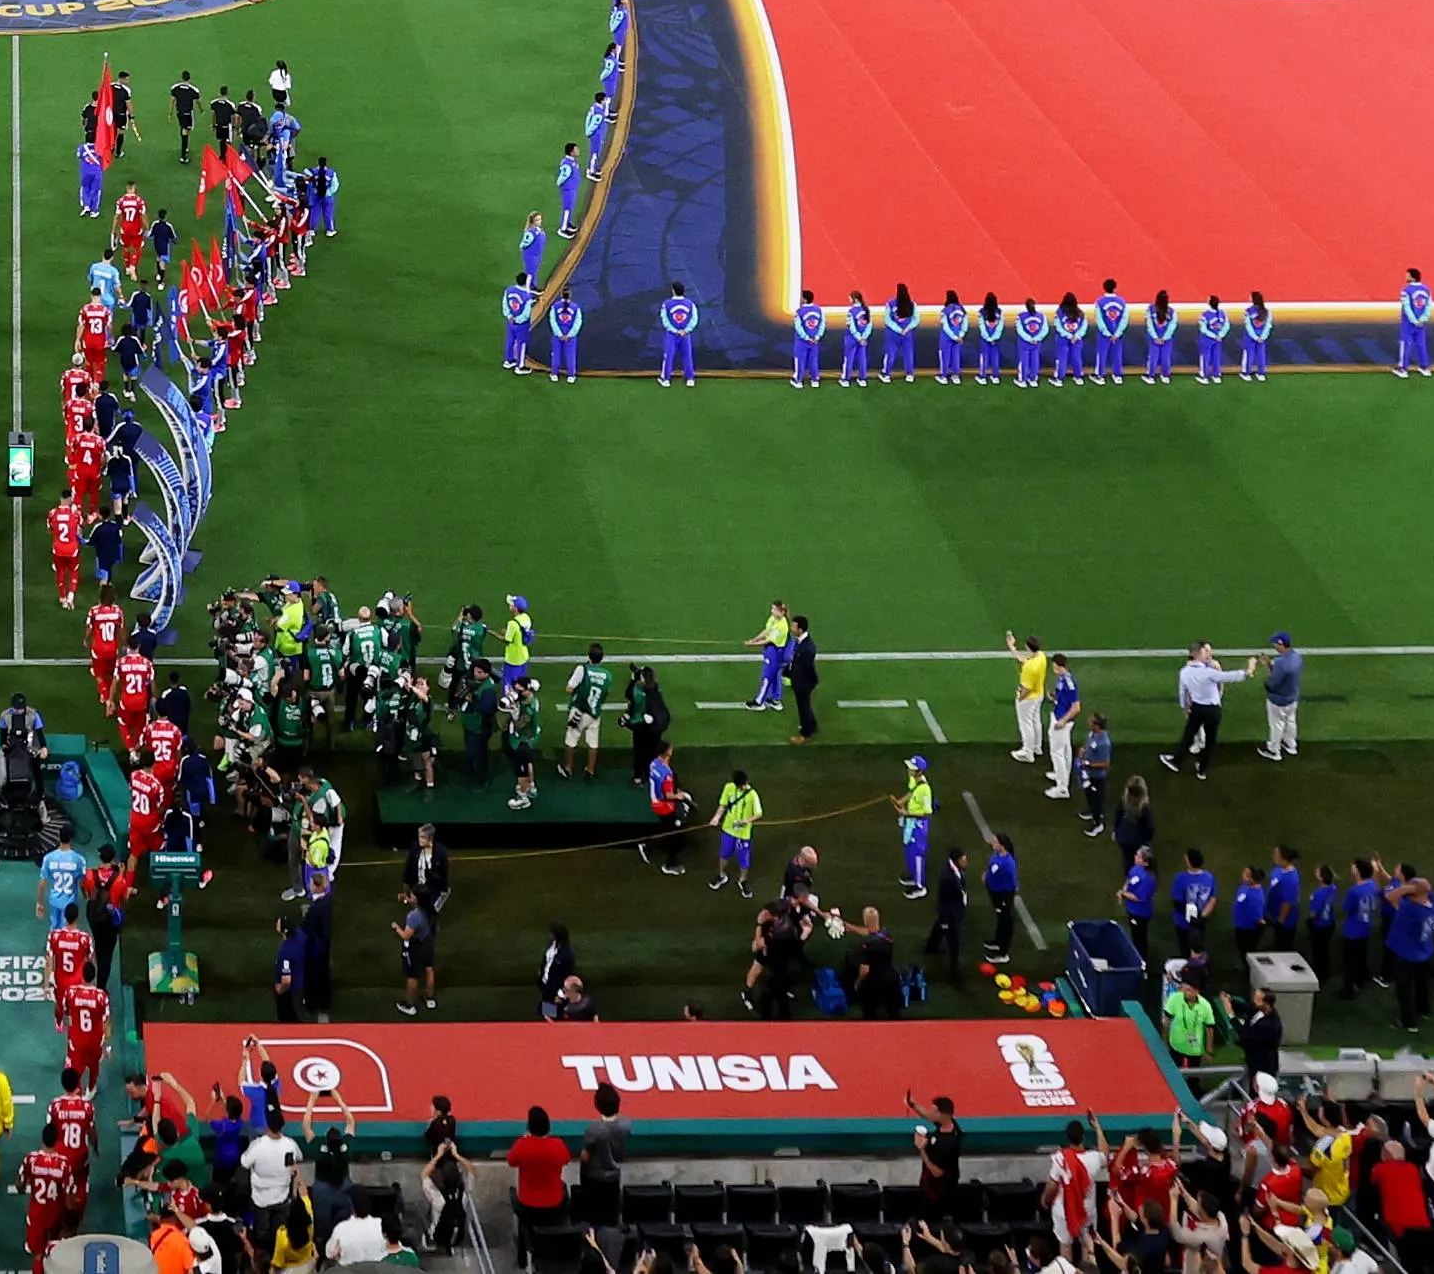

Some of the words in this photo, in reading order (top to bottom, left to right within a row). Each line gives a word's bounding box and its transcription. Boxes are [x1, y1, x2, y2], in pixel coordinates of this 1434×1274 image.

[88, 318, 103, 334] 13
[74, 415, 84, 432] 3
[83, 450, 93, 465] 4
[58, 523, 69, 542] 2
[98, 622, 116, 642] 10
[126, 673, 143, 694] 21
[152, 741, 172, 761] 25
[132, 790, 150, 814] 20
[154, 854, 196, 863] Hisense
[53, 871, 74, 894] 22
[63, 952, 74, 972] 5
[79, 1009, 92, 1032] 6
[561, 1054, 839, 1092] TUNISIA
[62, 1123, 82, 1149] 18
[36, 1177, 59, 1202] 24
